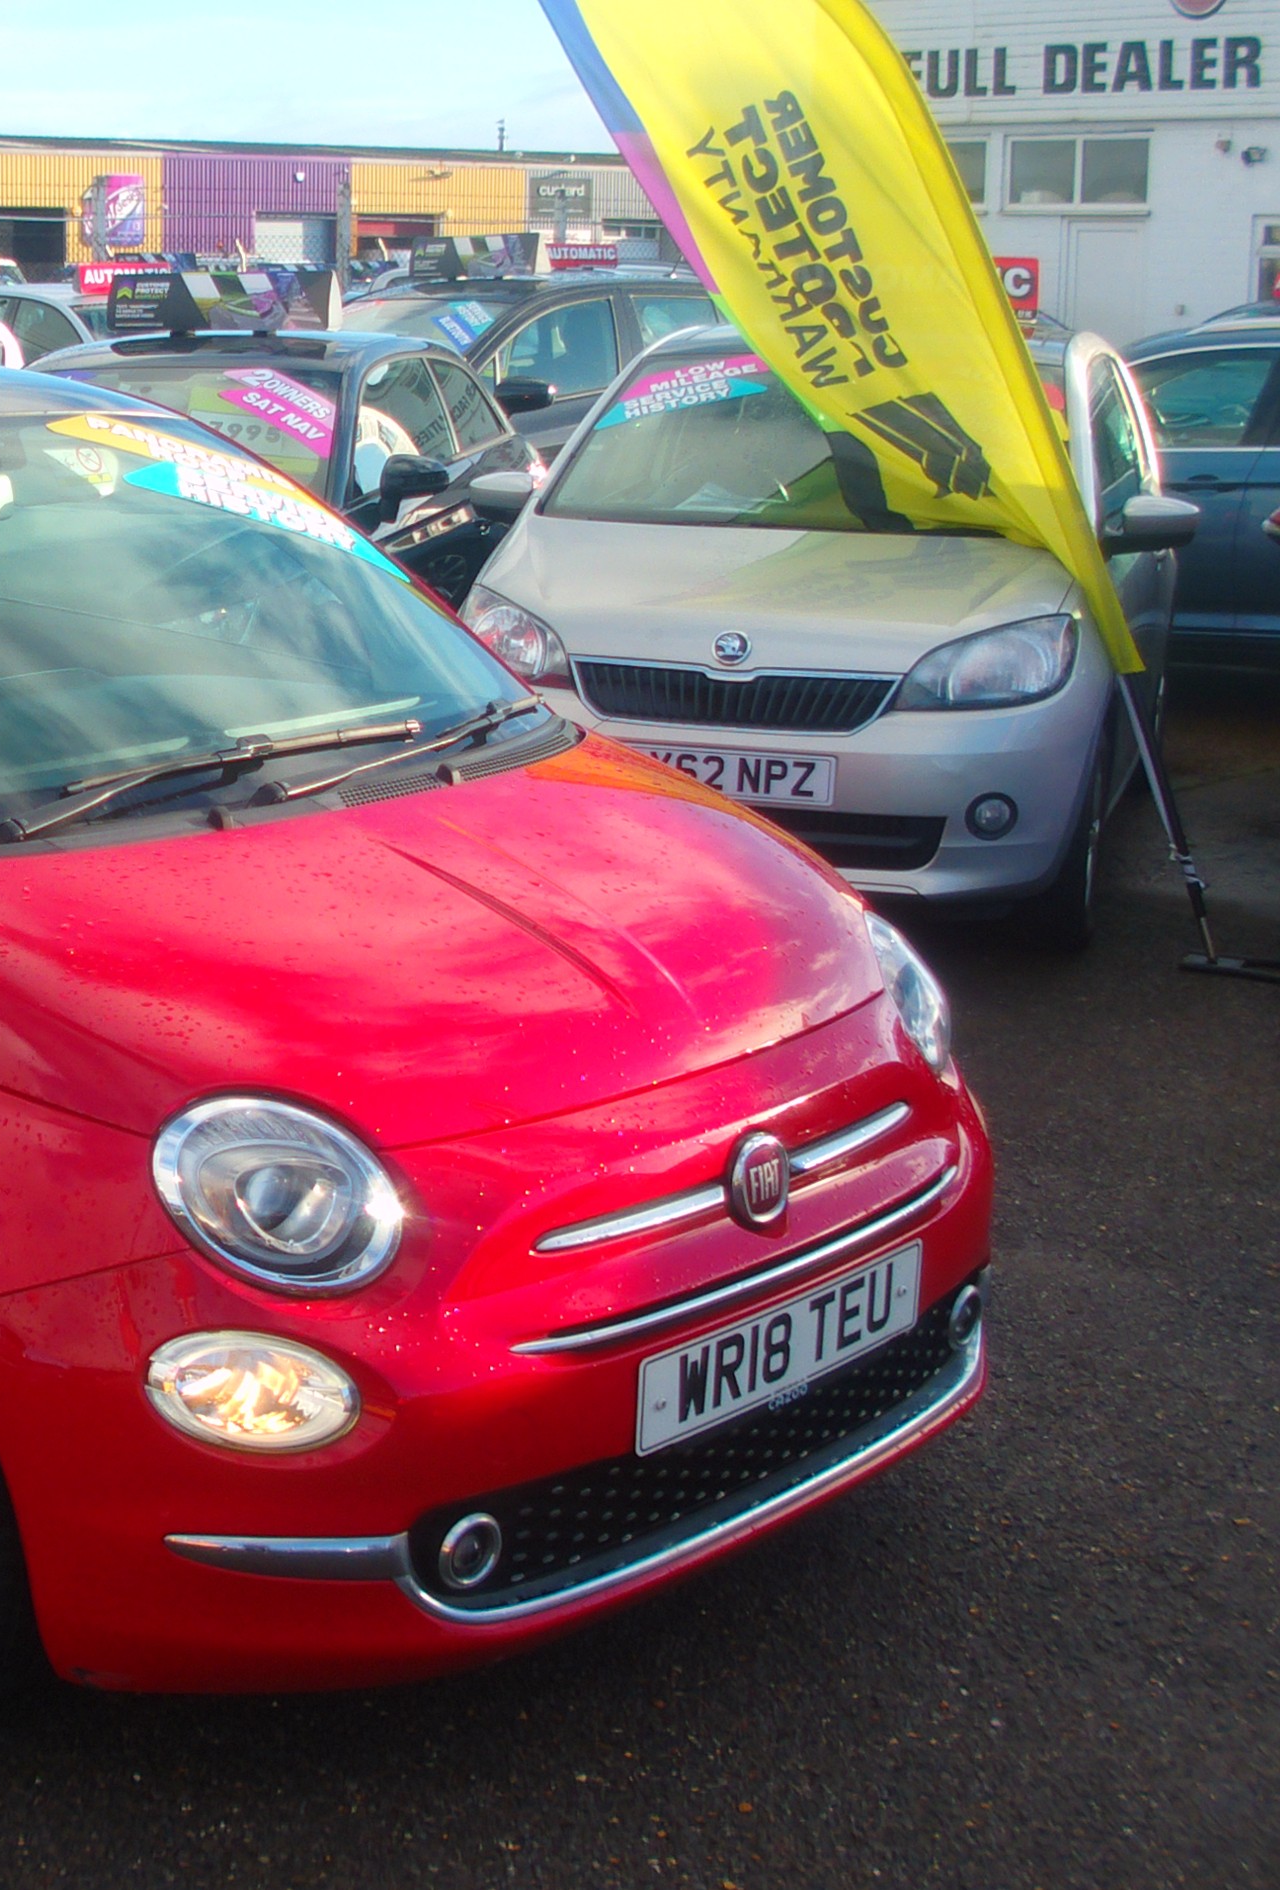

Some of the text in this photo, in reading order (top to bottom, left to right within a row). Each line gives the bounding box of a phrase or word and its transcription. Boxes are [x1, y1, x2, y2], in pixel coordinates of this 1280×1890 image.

[1042, 36, 1262, 94] DEALER
[650, 364, 758, 392] MILEAGE
[674, 361, 725, 378] LOW
[241, 369, 331, 419] 2 OWNERS
[623, 379, 729, 409] SERVICE
[624, 387, 731, 419] HISTORY
[242, 392, 326, 440] SAT NAV
[736, 757, 816, 797] NPZ
[749, 1158, 780, 1203] FIAT
[678, 1262, 893, 1424] WR18 TEU
